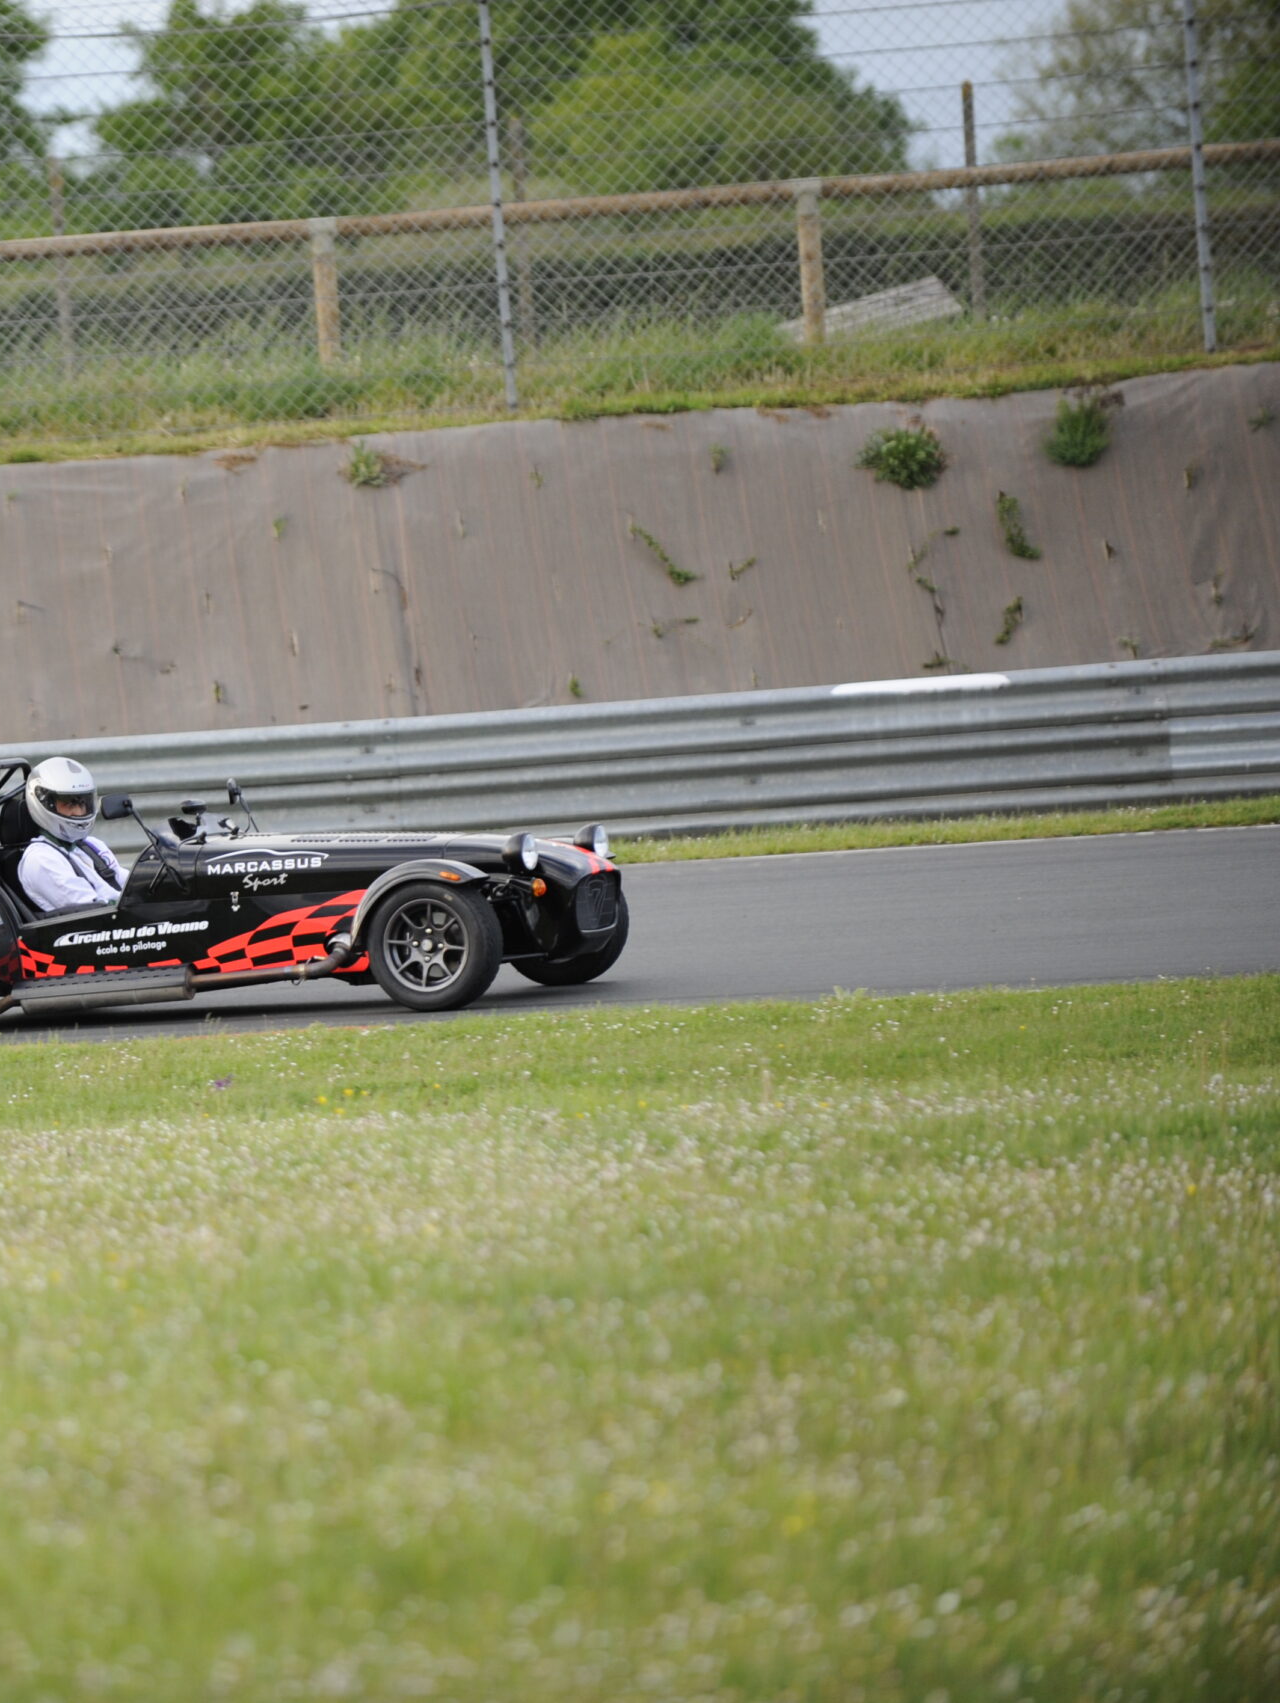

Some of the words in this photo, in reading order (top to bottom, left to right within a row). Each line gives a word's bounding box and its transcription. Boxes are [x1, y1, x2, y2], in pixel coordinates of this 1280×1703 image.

[207, 857, 322, 875] MARCASSUS
[242, 872, 288, 892] Sport
[53, 930, 111, 947] Circuit
[112, 927, 136, 941] Val
[136, 925, 156, 938] de
[157, 920, 209, 935] Vienne
[96, 943, 118, 955] école
[119, 942, 131, 952] de
[132, 940, 167, 953] pilotage
